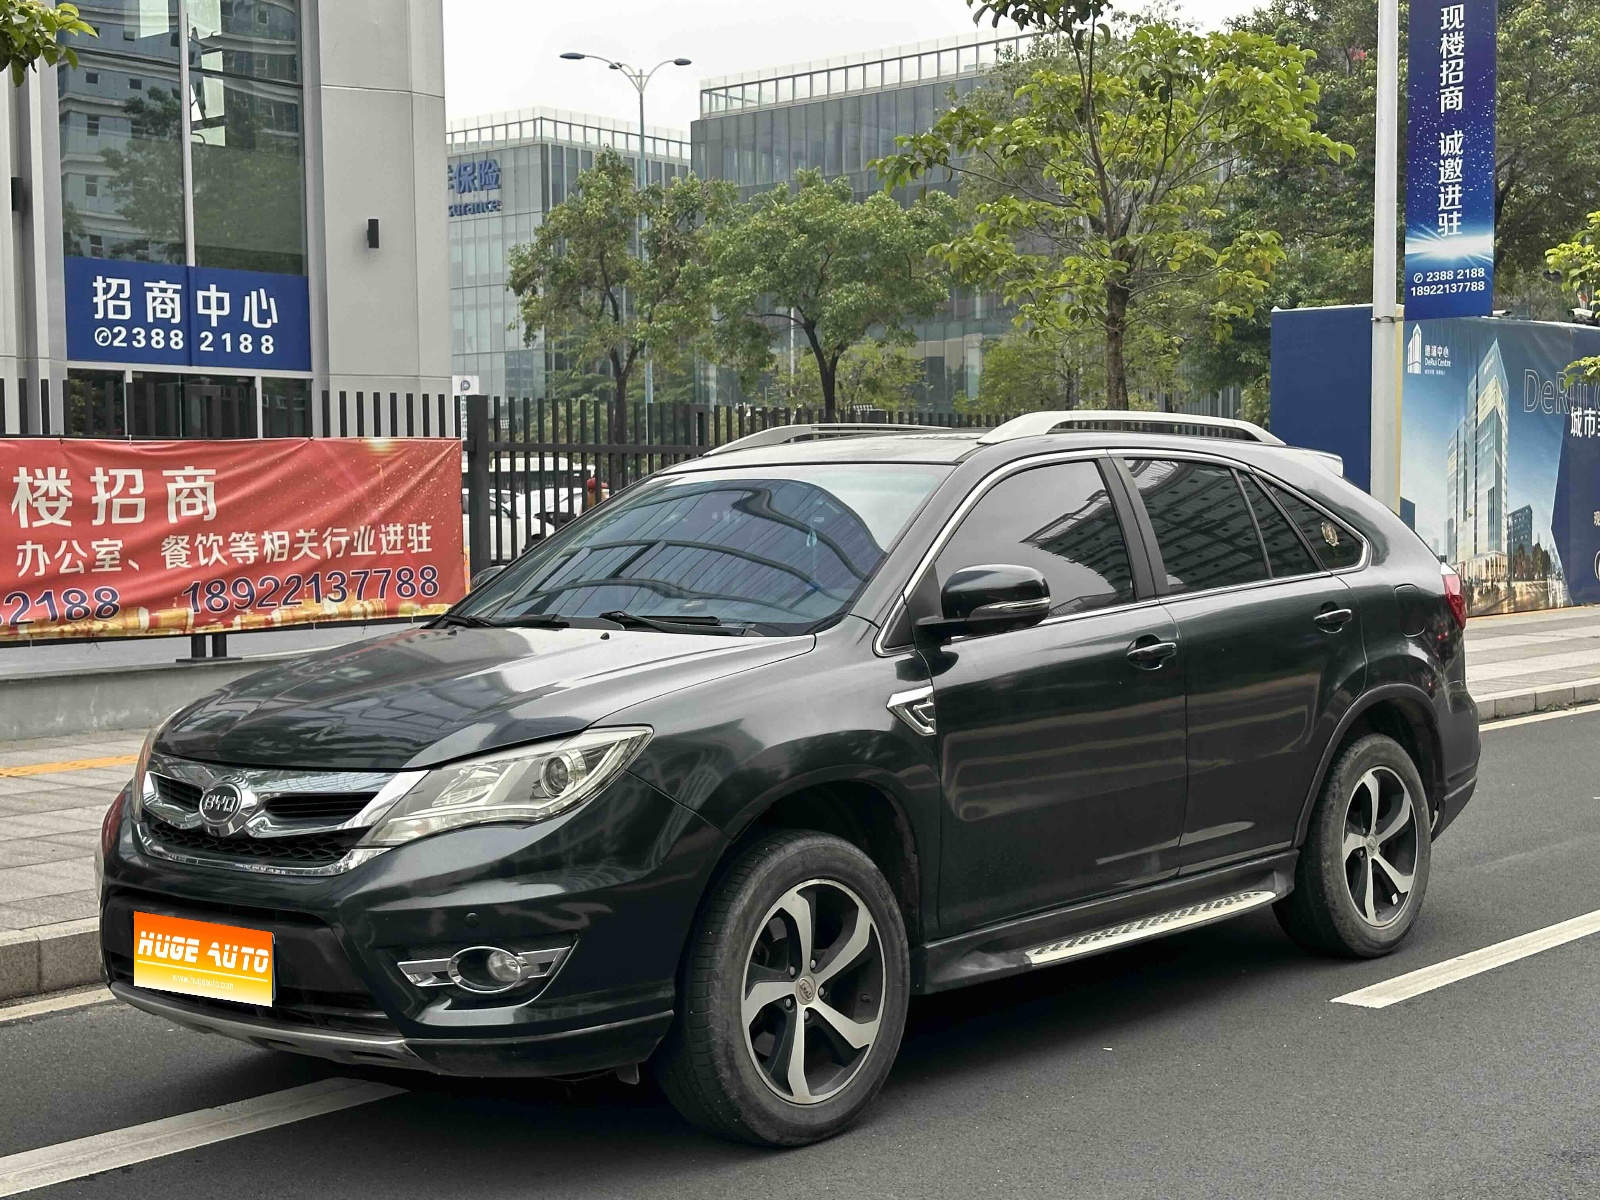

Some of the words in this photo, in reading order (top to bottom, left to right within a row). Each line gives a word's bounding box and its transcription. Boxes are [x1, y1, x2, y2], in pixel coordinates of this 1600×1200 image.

[1439, 3, 1465, 113] 现楼招商
[448, 159, 501, 194] 保险
[1437, 130, 1463, 237] 诚邀进驻
[1410, 281, 1485, 297] 18922137788
[1426, 270, 1454, 282] 2388
[1456, 267, 1485, 280] 2188
[93, 275, 279, 329] 招商中心
[112, 325, 184, 350] 2388
[199, 331, 275, 355] 2188
[11, 466, 217, 529] 楼招商
[0, 586, 120, 626] 2188
[182, 564, 439, 614] 18922137788
[203, 794, 236, 813] BYD
